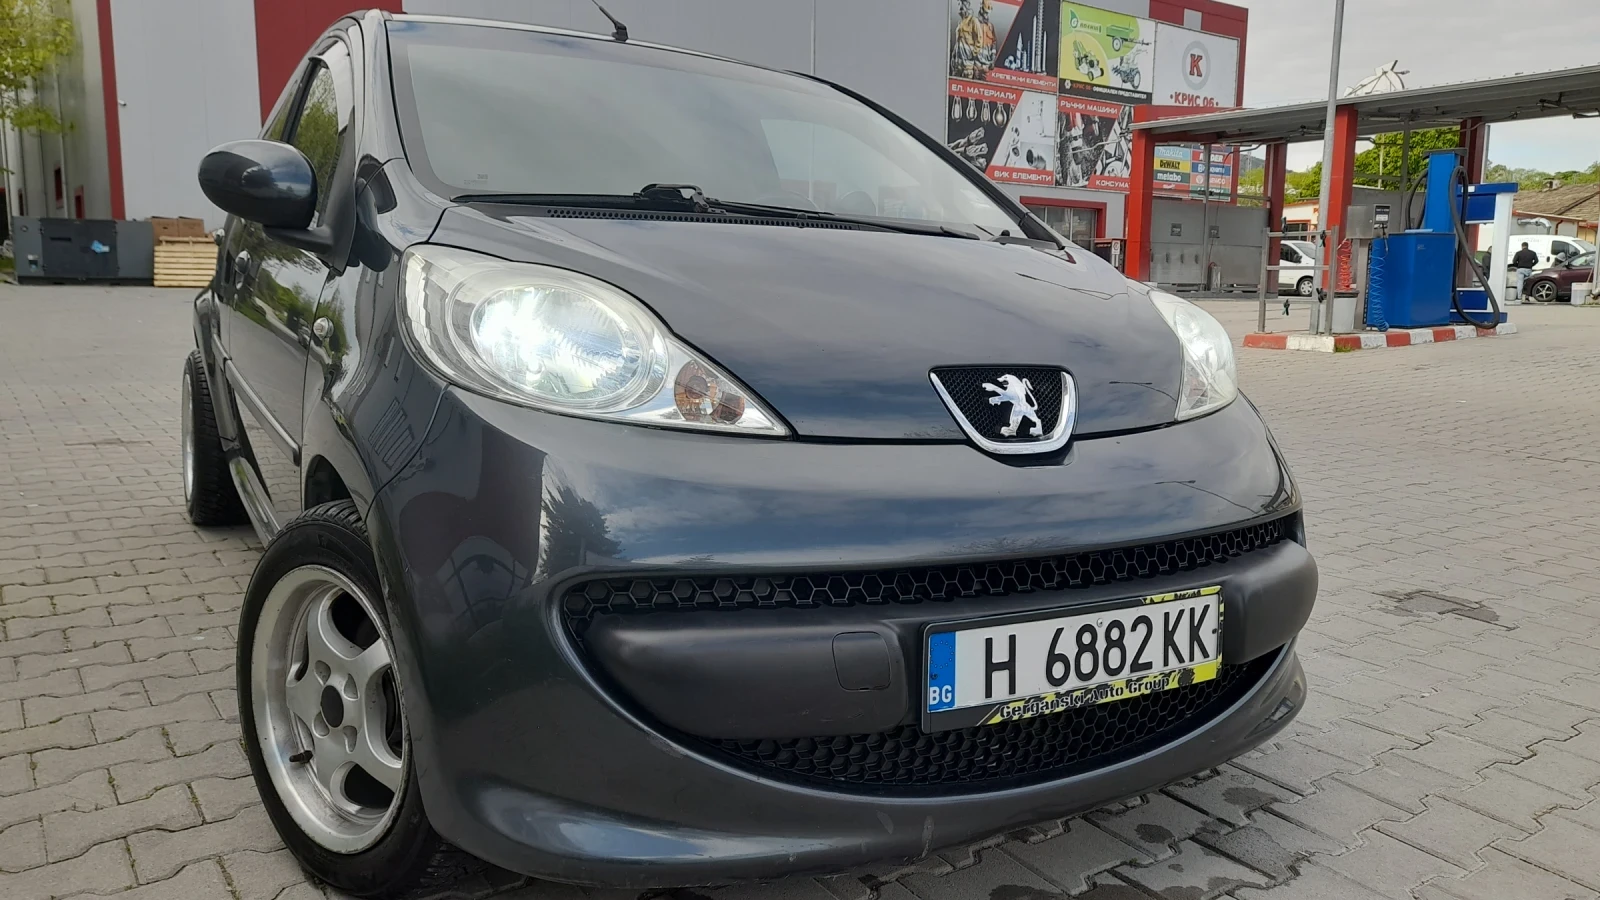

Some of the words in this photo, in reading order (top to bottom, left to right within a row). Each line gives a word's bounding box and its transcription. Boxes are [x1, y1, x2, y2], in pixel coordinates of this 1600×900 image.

[991, 72, 1026, 82] КРЕПЕЖНИ
[1026, 77, 1057, 88] ЕЛЕМЕНТИ
[951, 84, 964, 93] ЕЛ.
[967, 86, 1017, 100] МАТЕРИАЛИ
[1093, 86, 1118, 95] ОФИЦИАЛЕН
[1174, 91, 1201, 107] КРИС
[1060, 100, 1085, 110] РЪЧНИ
[1087, 104, 1118, 115] МАШИНИ
[994, 170, 1010, 178] ВИК
[1012, 172, 1052, 182] ЕЛЕМЕНТИ
[1095, 179, 1130, 188] КОНСУМА
[1156, 172, 1182, 182] metabo
[984, 634, 1017, 699] H
[929, 685, 953, 705] BG
[1000, 693, 1085, 718] Gerganski
[1088, 685, 1124, 703] Auto
[1128, 676, 1170, 694] Group
